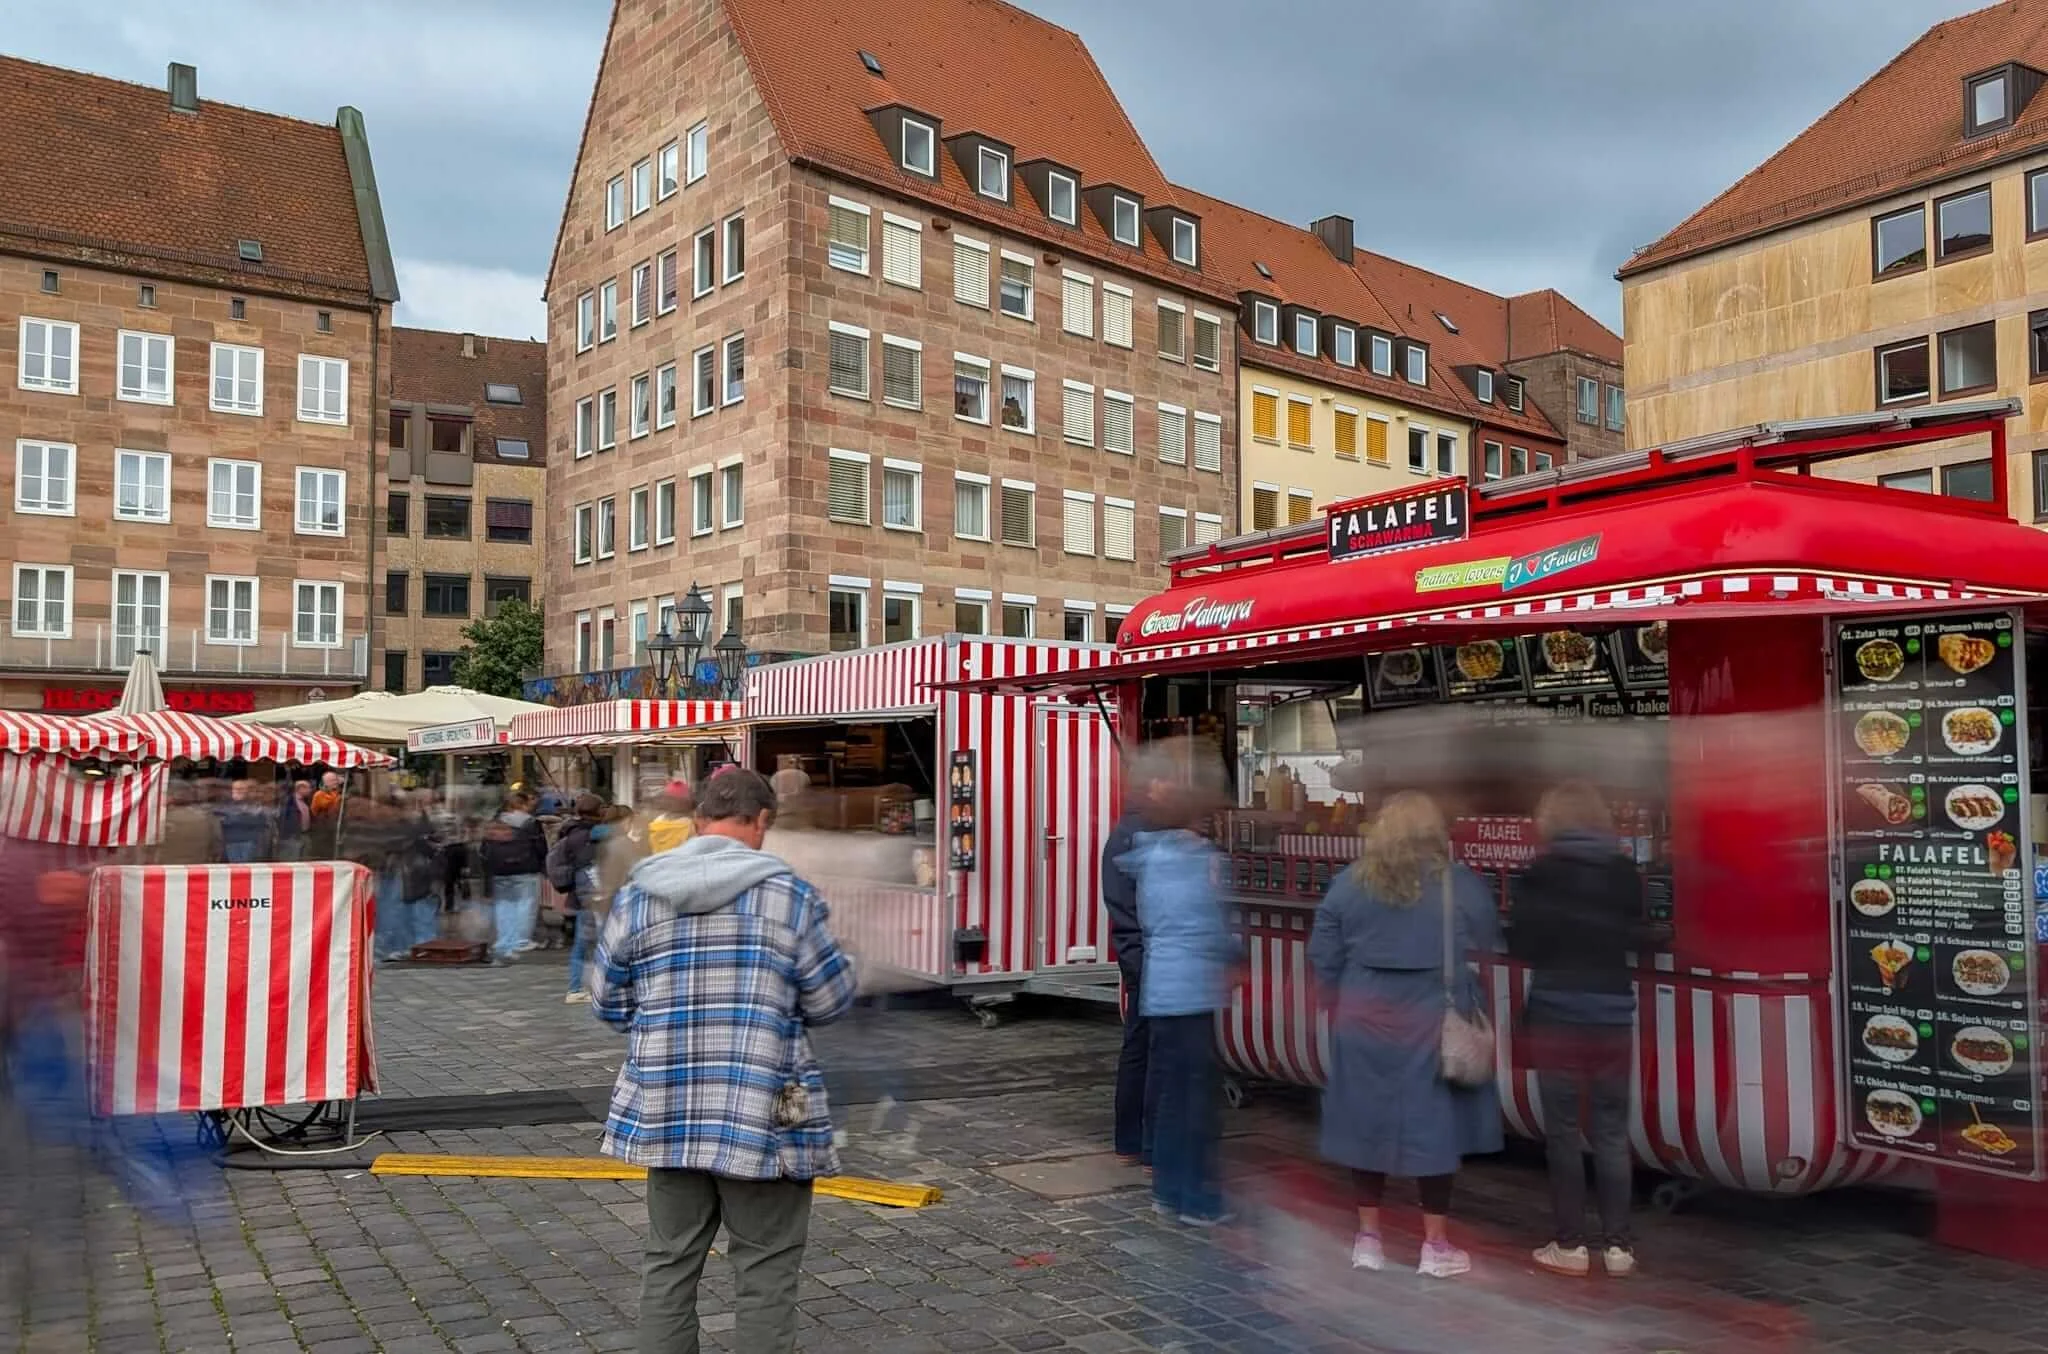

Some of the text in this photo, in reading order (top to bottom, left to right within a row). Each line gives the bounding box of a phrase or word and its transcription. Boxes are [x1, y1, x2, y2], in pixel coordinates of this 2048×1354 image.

[1331, 493, 1458, 547] FALAFEL
[1349, 522, 1433, 551] SCHAWARMA
[1542, 540, 1596, 572] Falafel
[1422, 565, 1503, 586] nature lovers
[1141, 596, 1255, 637] Green Palmyra
[1878, 628, 1899, 638] Wrap
[1973, 621, 1995, 632] Wrap
[43, 687, 123, 710] BLOC
[1558, 703, 1580, 718] Brot
[1477, 824, 1522, 840] FALAFEL
[1463, 842, 1536, 861] SCHAWARMA
[1879, 844, 1986, 865] FALAFEL
[1907, 866, 1932, 875] Falafel
[1932, 867, 1951, 877] Wrap
[1907, 877, 1933, 886] Falafel
[1933, 878, 1952, 888] Wrap
[1907, 887, 1933, 896] Falafel
[211, 898, 270, 910] KUNDE
[1908, 897, 1933, 907] Falafel
[1897, 907, 1908, 915] 11.
[1908, 907, 1933, 917] Falafel
[1897, 917, 1909, 926] 12.
[1909, 918, 1933, 928] Falafel
[1934, 936, 1946, 945] 14.
[1936, 1011, 1950, 1021] 16.
[1983, 1016, 2008, 1029] Wrap
[1854, 1075, 1866, 1084] 17.
[1867, 1076, 1897, 1089] Chicken
[1898, 1082, 1921, 1094] Wrap
[1955, 1090, 1995, 1105] Pommes
